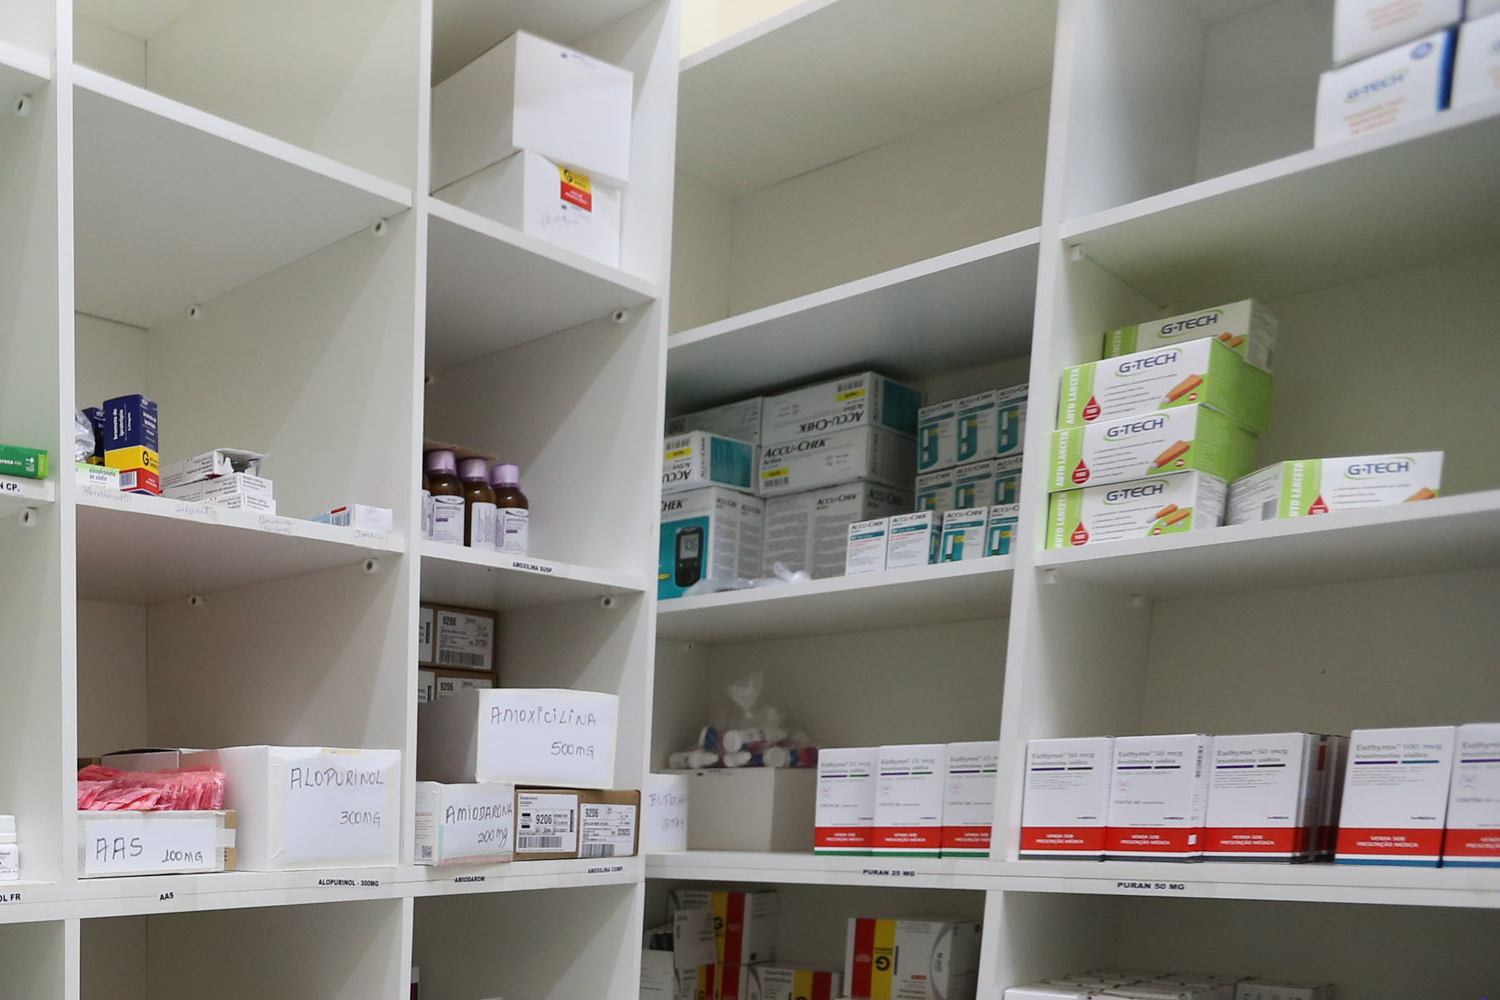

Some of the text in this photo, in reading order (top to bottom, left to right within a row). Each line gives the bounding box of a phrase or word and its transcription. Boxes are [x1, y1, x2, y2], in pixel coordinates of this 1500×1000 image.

[1161, 313, 1218, 336] G-TECH
[1118, 352, 1177, 374] G-TECH
[1107, 418, 1164, 439] G-TECH
[763, 437, 830, 460] ACCU-CHEK
[1347, 460, 1410, 476] G-TECH
[5, 483, 21, 492] CP.
[1106, 483, 1164, 505] G-TECH
[536, 814, 552, 825] 9206
[95, 838, 143, 861] AAS
[1117, 882, 1152, 890] PURAN
[1169, 883, 1185, 891] MG
[10, 893, 21, 902] FR
[159, 891, 174, 901] AAS
